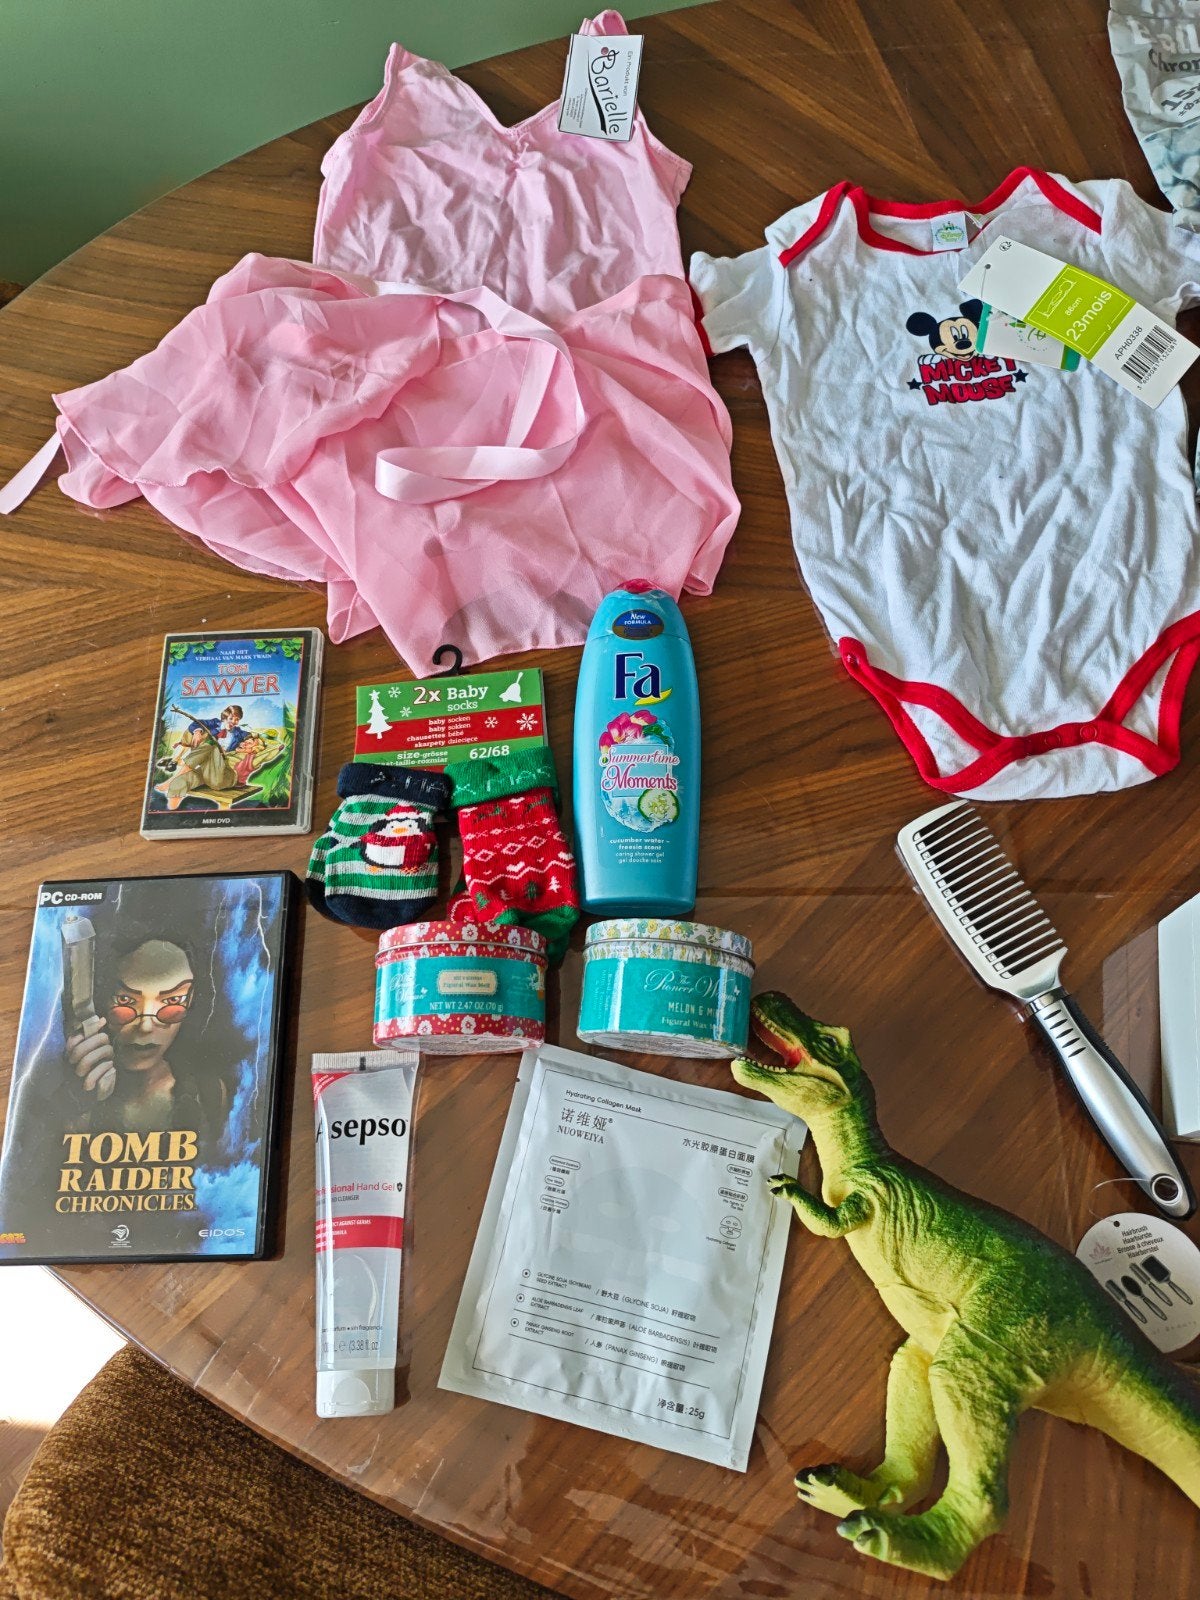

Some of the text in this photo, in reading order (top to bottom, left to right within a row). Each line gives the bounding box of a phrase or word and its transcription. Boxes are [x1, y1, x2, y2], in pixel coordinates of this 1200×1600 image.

[591, 50, 628, 134] Barielle
[1066, 290, 1112, 342] 23mois
[1114, 326, 1143, 360] APH0338
[922, 374, 1016, 406] MOUSE
[630, 612, 646, 620] New
[218, 662, 249, 674] TOM
[614, 652, 661, 700] Fa
[181, 674, 280, 696] SAWYER
[413, 685, 488, 705] 2x Baby
[447, 700, 478, 712] socks
[470, 745, 510, 759] 62/68
[603, 747, 679, 764] Summertime
[602, 764, 678, 790] Moments
[40, 891, 102, 905] PC CD-ROM
[644, 968, 694, 993] Pioneer
[430, 1002, 443, 1010] NET
[475, 1002, 485, 1010] OZ
[486, 1002, 497, 1010] (70
[668, 1002, 695, 1014] MELON
[662, 1017, 690, 1026] Figural
[566, 1089, 641, 1113] Hydrating Collagen Mask
[557, 1125, 604, 1144] NUOWEIYA
[62, 1130, 198, 1164] TOMB
[58, 1166, 195, 1192] RAIDER
[356, 1182, 379, 1191] Hand
[382, 1182, 395, 1191] Gel
[55, 1194, 194, 1213] CHRONICLES
[199, 1228, 245, 1237] EIDOS
[1122, 1225, 1148, 1237] Hairbrush
[537, 1272, 555, 1280] GLYCINE
[548, 1280, 567, 1289] EXTRACT
[531, 1302, 550, 1310] EXTRACT
[525, 1327, 544, 1335] EXTRACT
[541, 1325, 560, 1334] GINSENG
